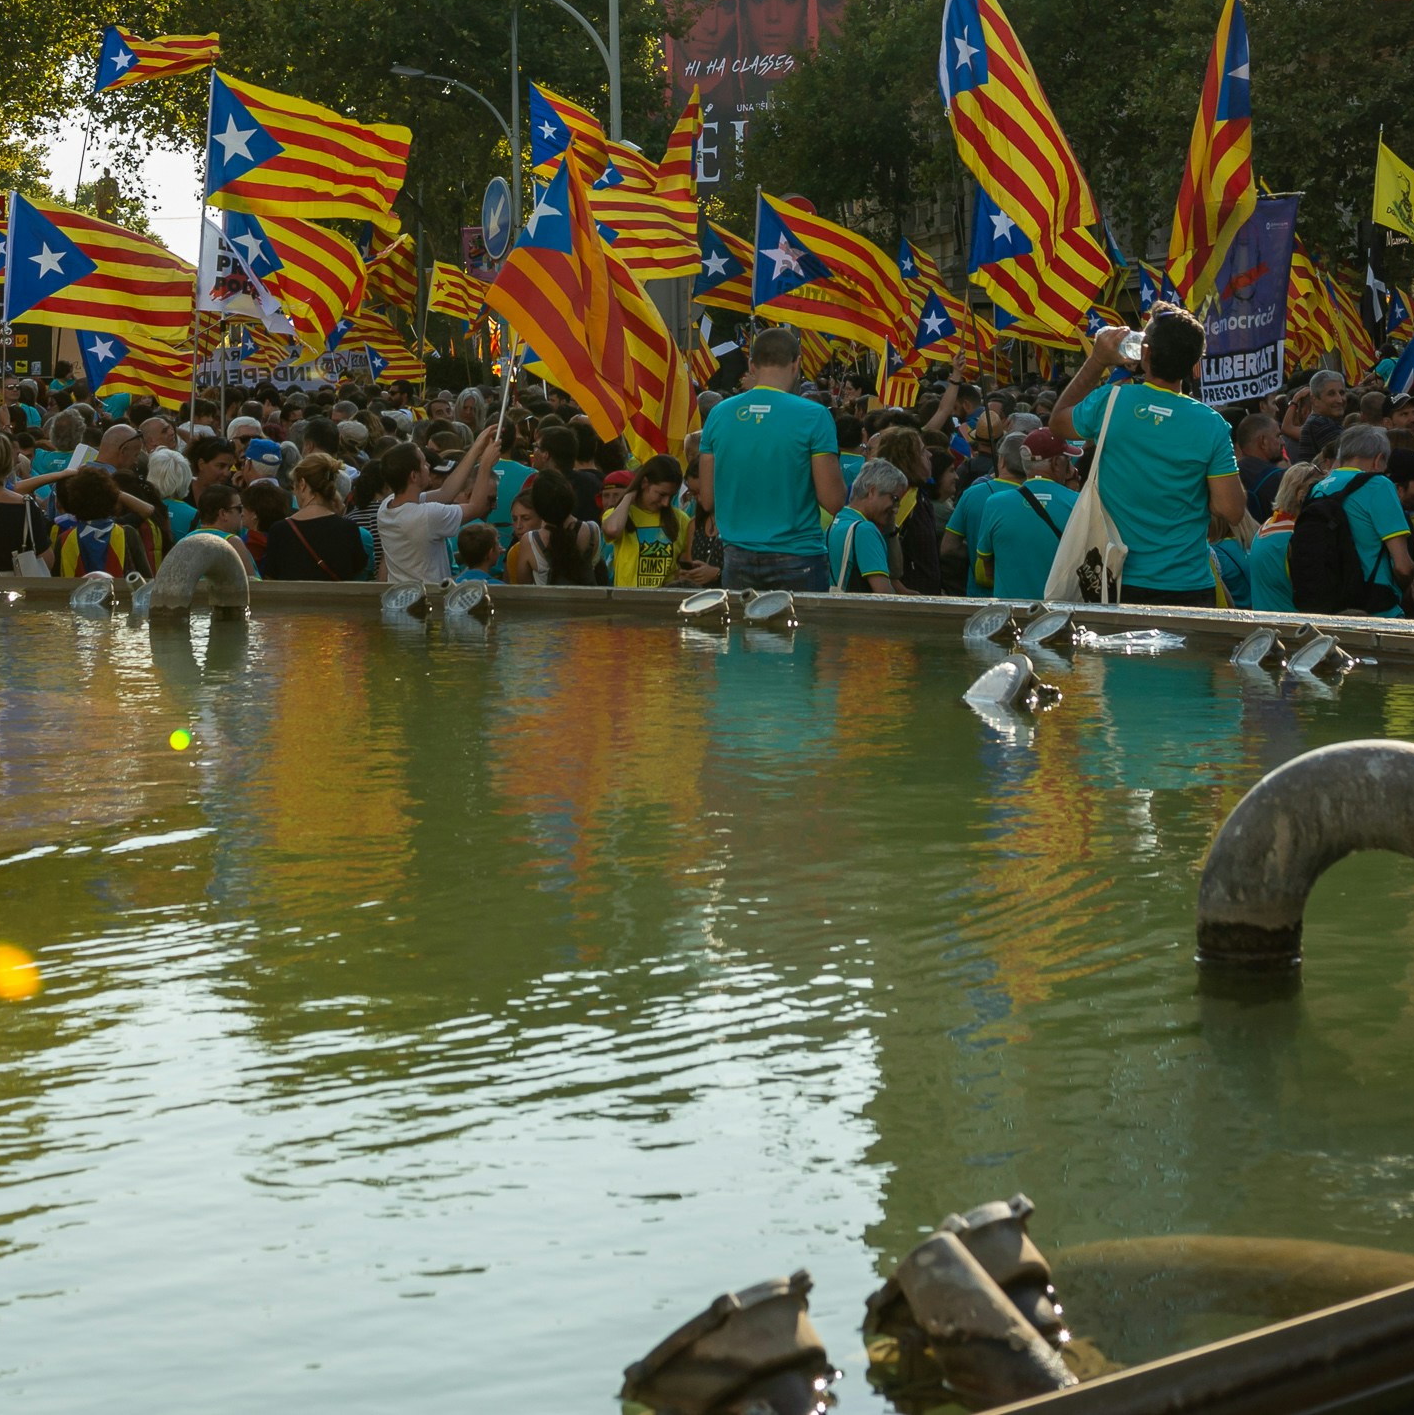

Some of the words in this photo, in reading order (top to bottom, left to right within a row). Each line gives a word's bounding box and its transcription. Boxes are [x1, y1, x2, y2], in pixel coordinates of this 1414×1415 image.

[684, 60, 701, 77] HI
[706, 58, 726, 77] HA
[731, 54, 795, 76] CLASSES
[736, 103, 755, 113] UNA
[1202, 345, 1275, 383] LLIBERTAT
[1203, 384, 1240, 403] PRESOS
[640, 558, 664, 574] CIMS
